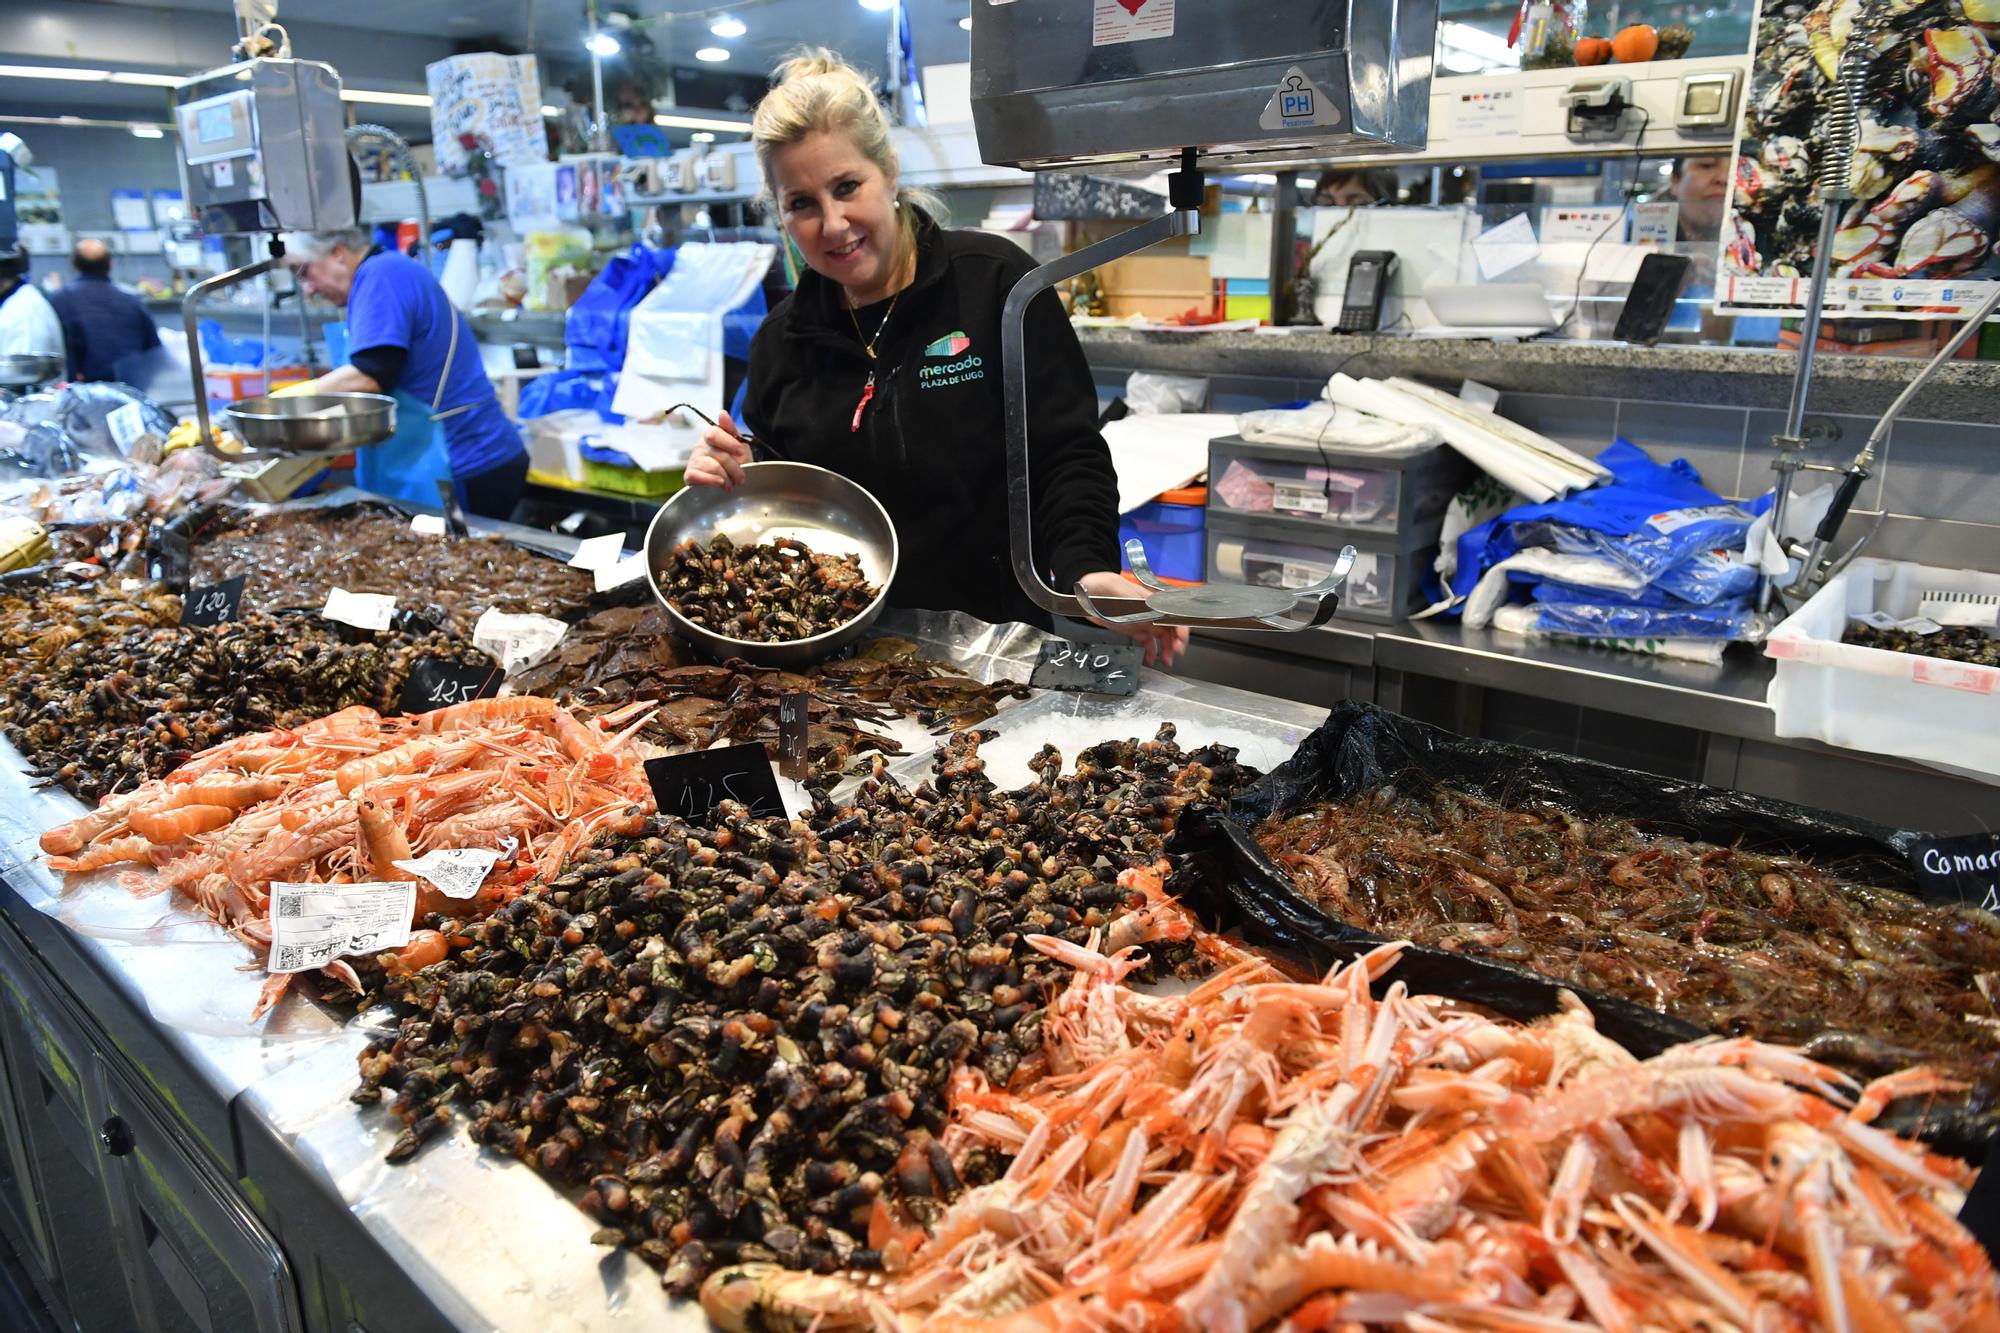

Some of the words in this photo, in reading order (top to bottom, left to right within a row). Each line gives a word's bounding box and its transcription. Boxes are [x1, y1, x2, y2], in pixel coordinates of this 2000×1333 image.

[1285, 95, 1309, 113] PH
[920, 355, 982, 379] mercado
[921, 378, 948, 389] PLAZA
[949, 376, 960, 385] DE
[960, 370, 984, 382] LUGO
[194, 591, 226, 615] 120
[1050, 650, 1109, 669] 240
